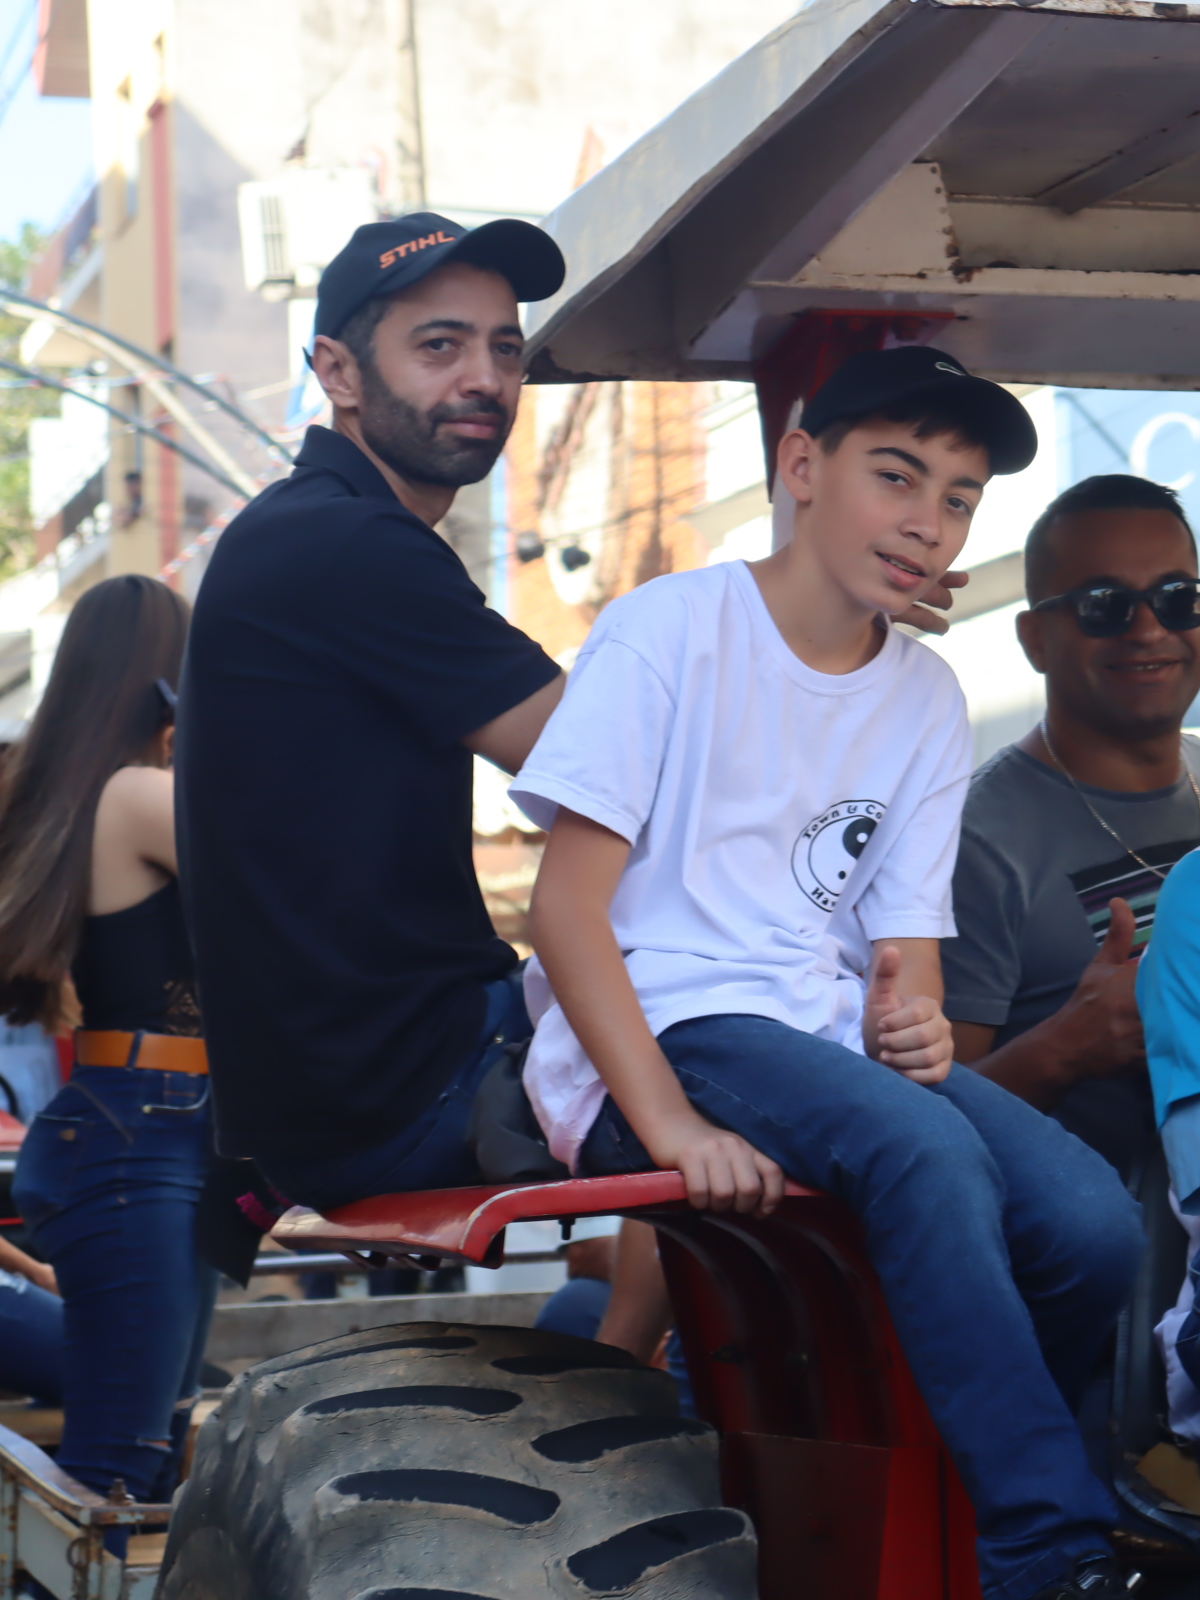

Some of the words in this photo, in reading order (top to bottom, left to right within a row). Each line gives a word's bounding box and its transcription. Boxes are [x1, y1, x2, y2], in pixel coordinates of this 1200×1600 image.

[379, 230, 455, 269] STIHL
[803, 810, 840, 840] Town
[865, 804, 883, 820] Co
